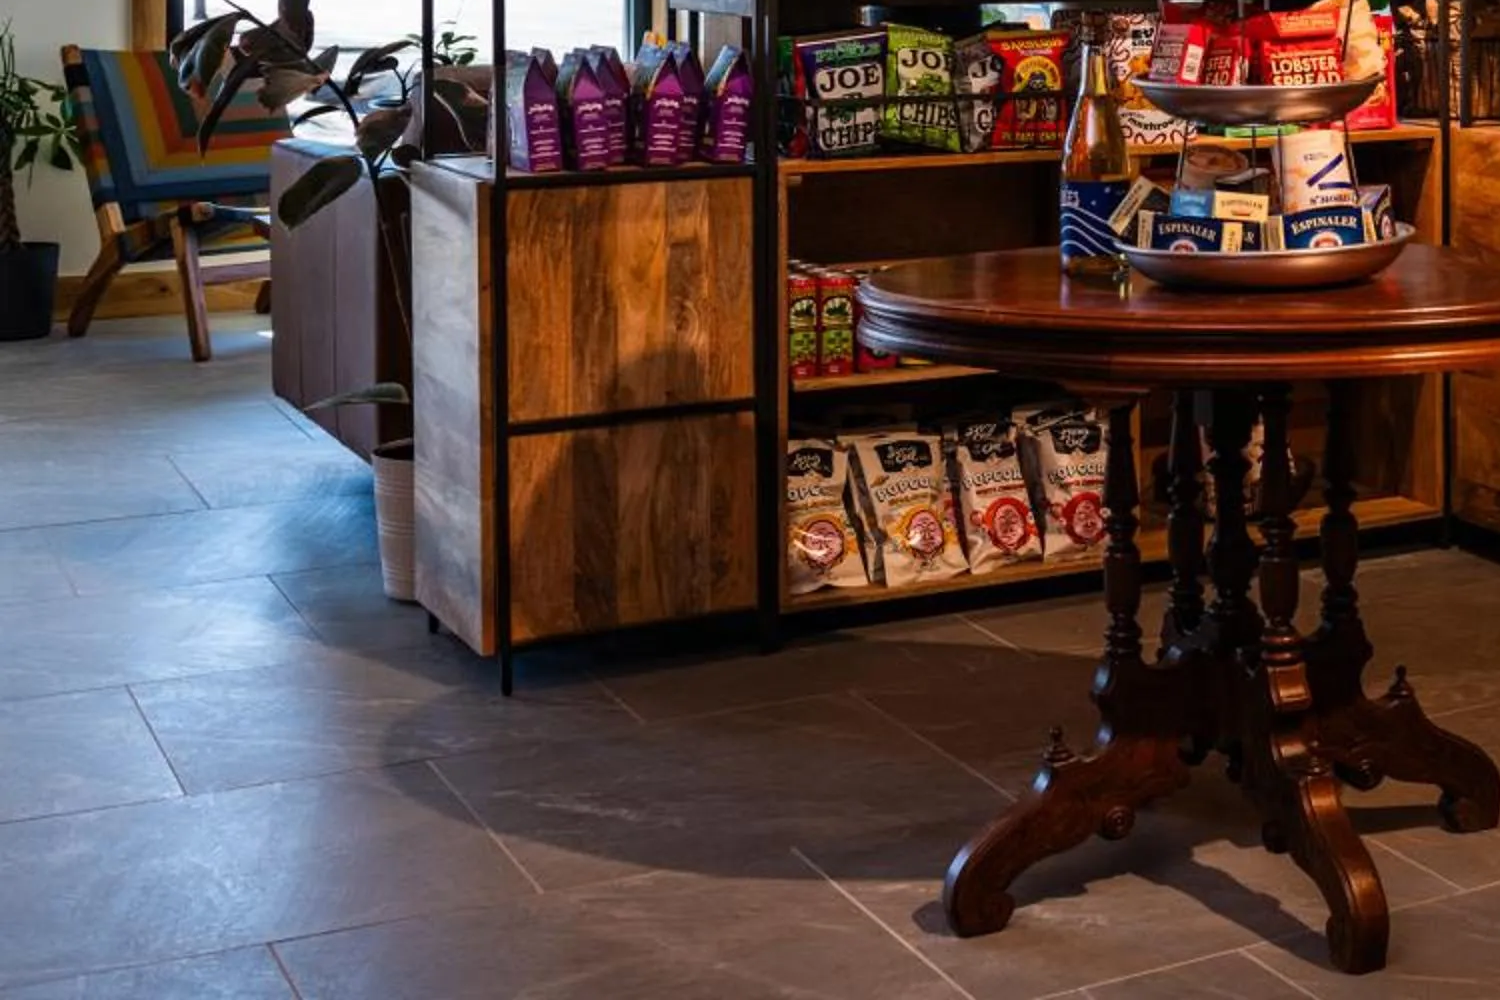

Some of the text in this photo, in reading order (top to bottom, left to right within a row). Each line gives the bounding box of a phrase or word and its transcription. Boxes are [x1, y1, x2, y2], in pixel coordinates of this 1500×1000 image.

[1271, 55, 1339, 75] LOBSTER
[820, 64, 881, 93] JOE
[1273, 71, 1341, 86] SPREAD
[1158, 221, 1217, 243] ESPINALER
[1291, 215, 1359, 236] ESPINALER
[962, 467, 1023, 492] POPCOR
[1048, 462, 1105, 485] POPCOR
[874, 476, 931, 502] POPCO
